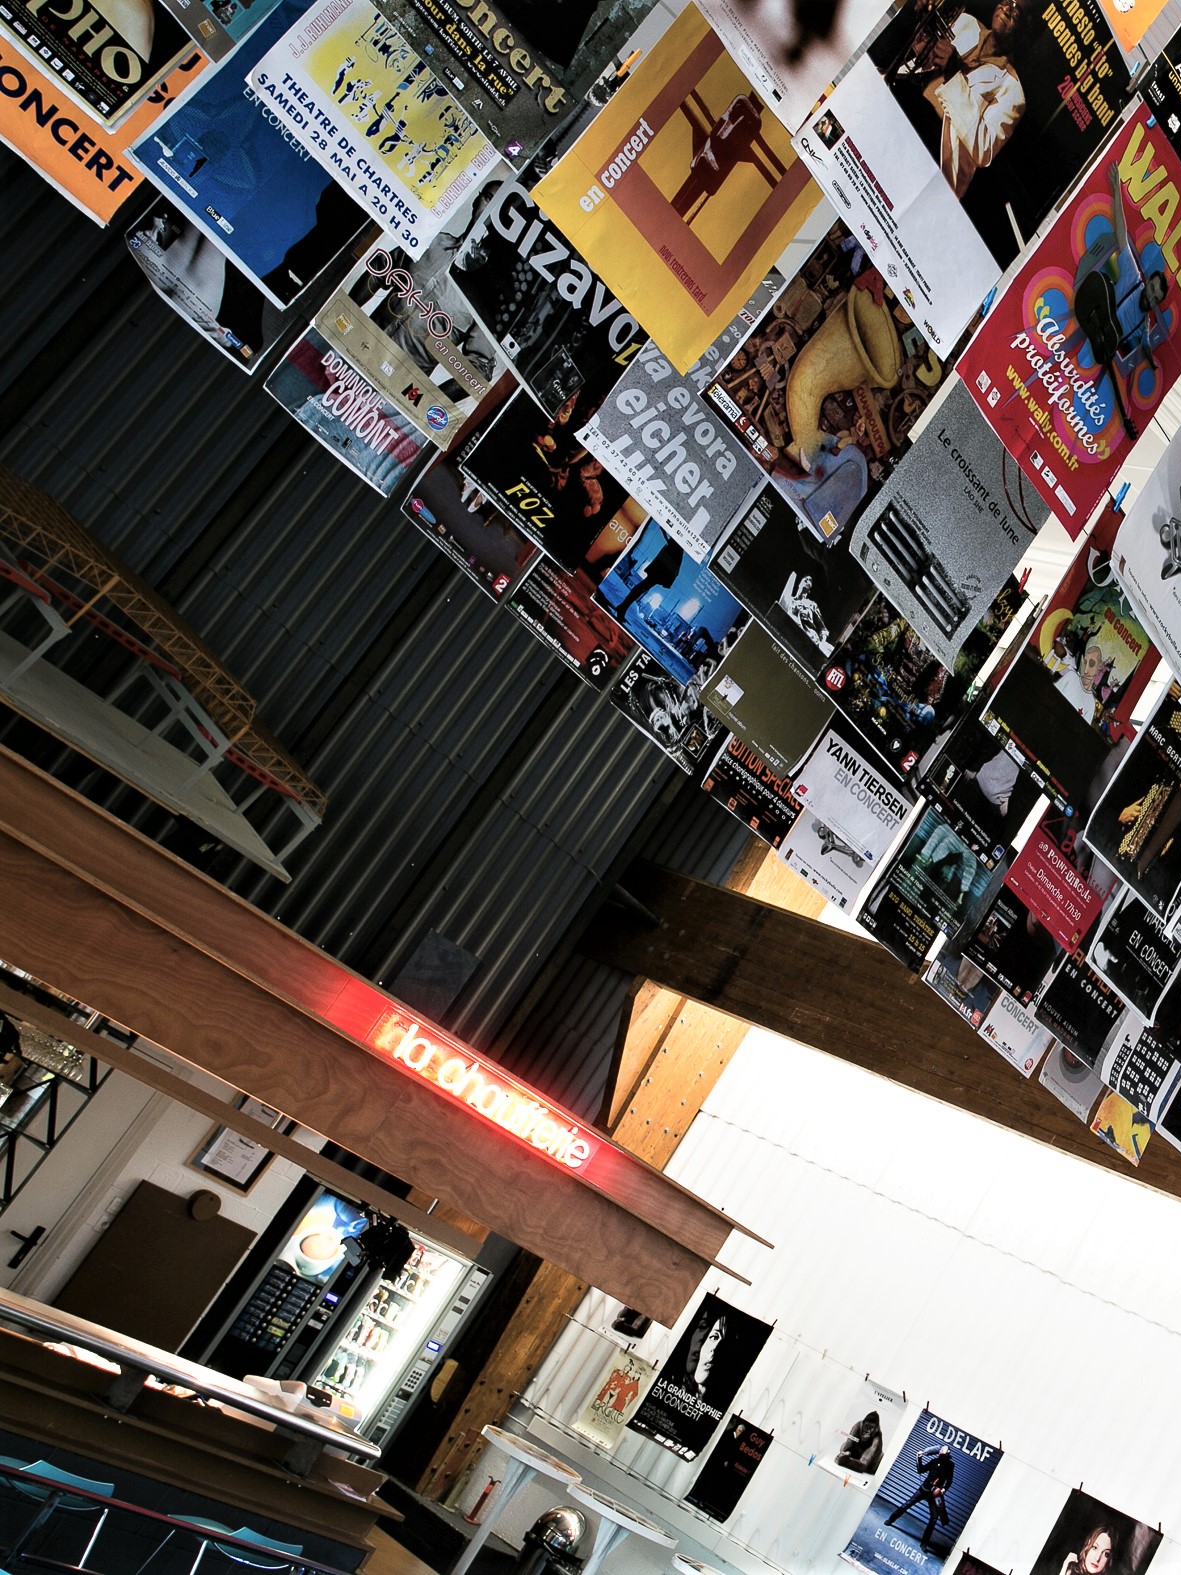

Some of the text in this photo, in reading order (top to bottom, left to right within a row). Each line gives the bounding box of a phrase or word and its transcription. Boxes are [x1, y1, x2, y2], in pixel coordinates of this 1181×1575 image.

[444, 22, 486, 72] dans la
[458, 24, 519, 91] SORTIE LE 7 AVRIL
[1042, 2, 1115, 127] puentes big band
[1057, 75, 1074, 99] 20
[0, 54, 134, 193] ONCERT
[242, 87, 312, 163] EN CONCERT
[281, 71, 419, 225] THEATRE DE CHARTRES
[257, 73, 420, 249] SAMEDI 28 MAI A 20 H 30
[578, 117, 656, 214] en concert
[659, 245, 696, 293] nous rentrerons
[320, 350, 388, 412] DOMINIQUE
[434, 339, 487, 397] en concert
[322, 380, 399, 456] COMONT
[708, 384, 741, 421] Télérama
[1005, 365, 1079, 472] www.wally.com.fr
[615, 388, 715, 508] eicher
[666, 386, 738, 481] evora
[601, 439, 610, 449] 02
[609, 448, 620, 459] 37
[619, 457, 629, 469] 42
[636, 475, 647, 487] 18
[937, 429, 1021, 546] Le croissant de lune
[503, 482, 554, 528] FOZ
[963, 487, 984, 514] LAO SHE
[1103, 606, 1142, 656] en concert
[620, 667, 640, 695] LES
[828, 668, 846, 687] RTL
[1147, 724, 1166, 746] MARC
[762, 787, 775, 800] pour
[826, 737, 908, 821] YANN TIERSEN
[833, 770, 852, 791] EN
[850, 782, 900, 832] CONCERT
[1034, 868, 1066, 901] Dimanche
[1062, 900, 1082, 921] 17h30
[1129, 930, 1144, 945] EN
[1142, 942, 1173, 984] CONCERT
[1000, 994, 1040, 1036] CONCERT
[1064, 964, 1118, 1019] EN CONCERT
[393, 1023, 436, 1071] la
[651, 1386, 704, 1422] EN CONCERT
[657, 1378, 723, 1421] LA GRANDE SOPHIE
[926, 1417, 994, 1462] OLDELAF
[874, 1528, 929, 1567] EN CONCERT
